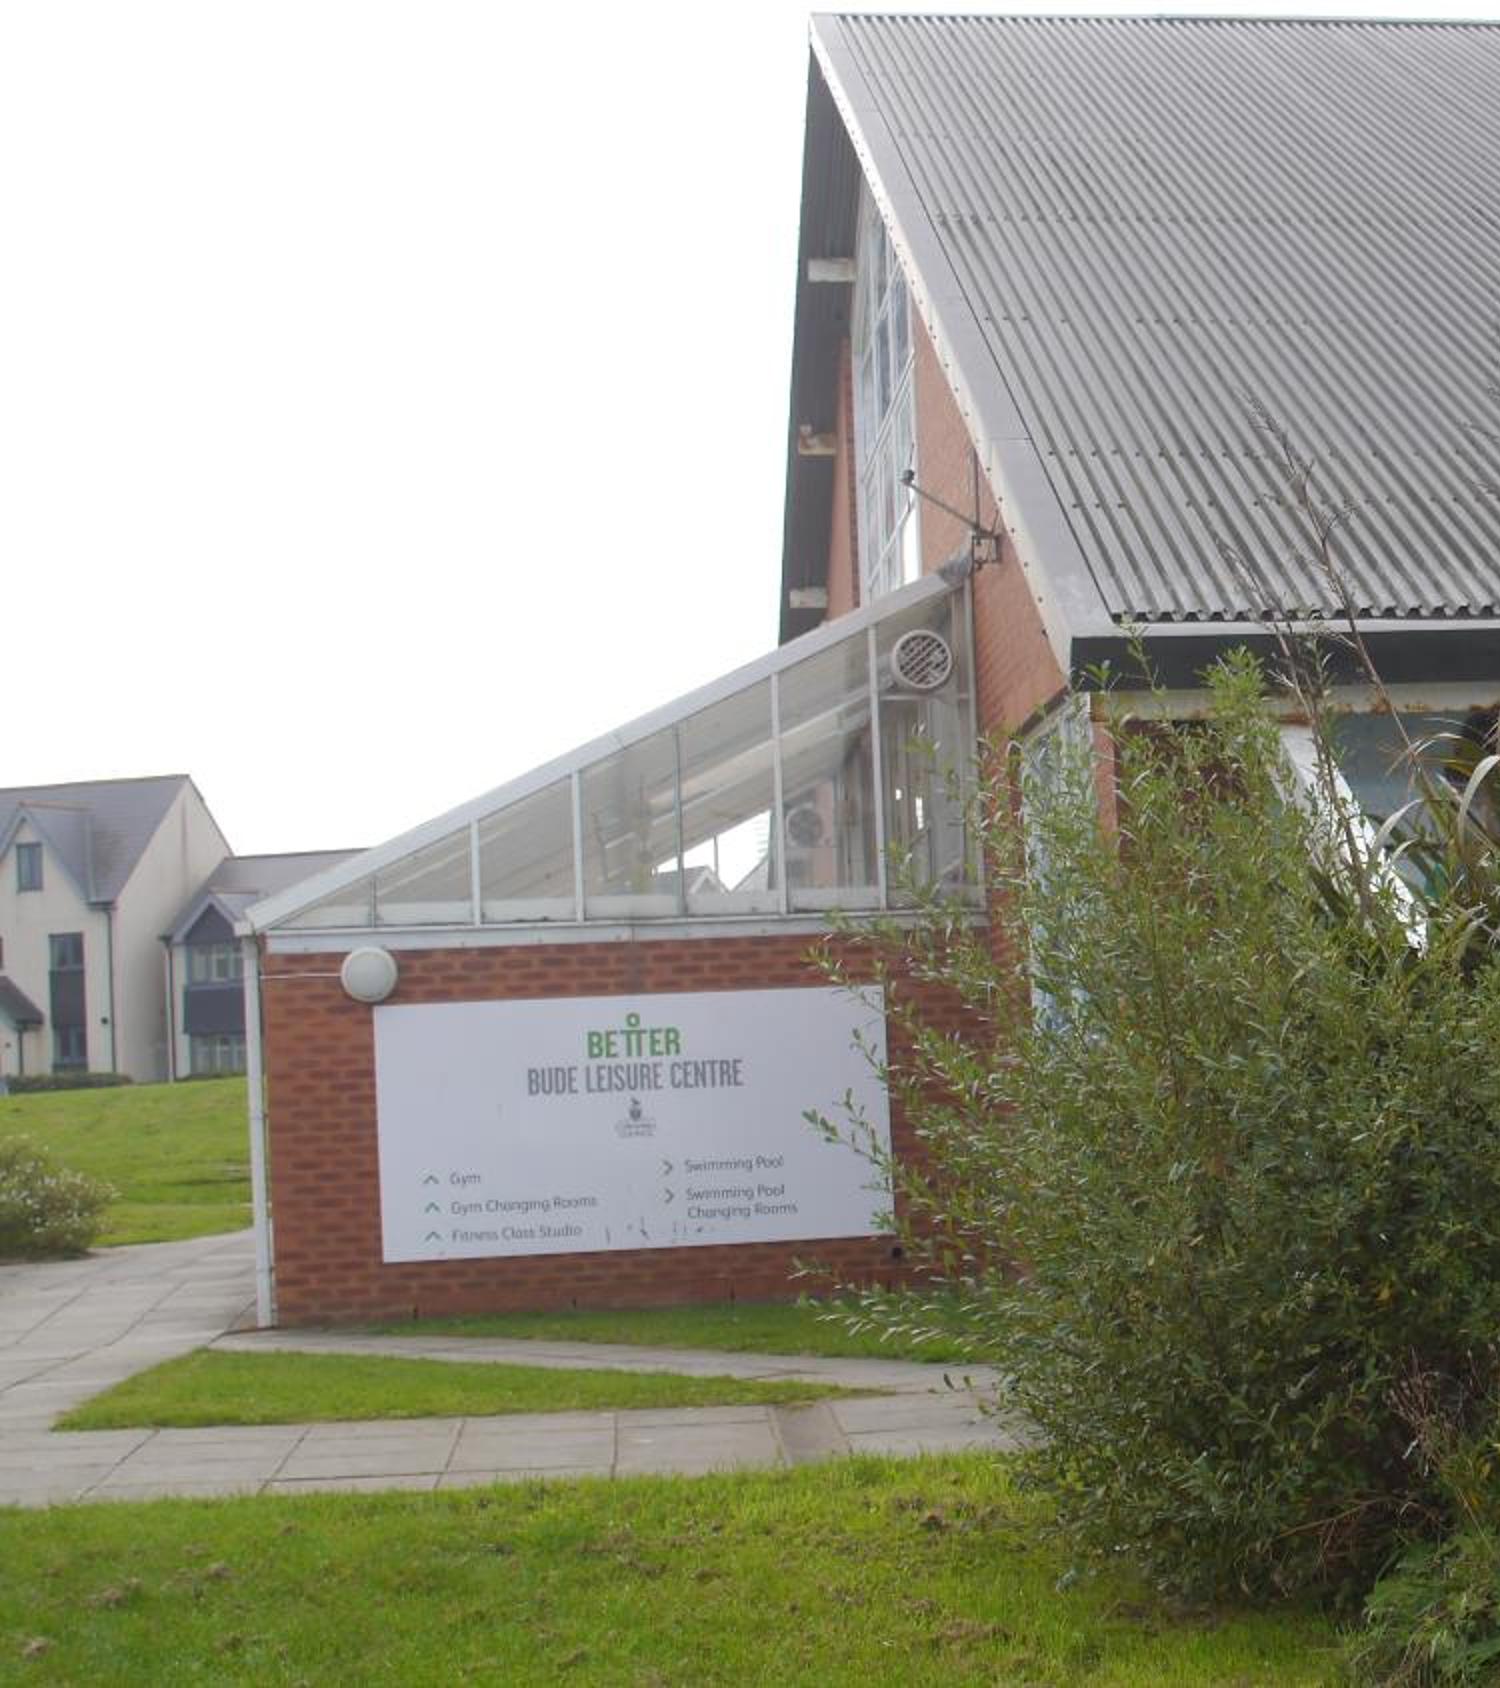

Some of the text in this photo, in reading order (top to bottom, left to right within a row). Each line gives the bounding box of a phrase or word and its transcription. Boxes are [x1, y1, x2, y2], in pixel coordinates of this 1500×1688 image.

[587, 1012, 681, 1059] BETTER
[527, 1059, 744, 1096] BUDE LEISURE CENTRE
[685, 1154, 784, 1174] Swimming Pool
[450, 1171, 482, 1188] Gym
[686, 1184, 785, 1202] Swimming Pool
[451, 1195, 599, 1216] Gym Changing Rooms
[687, 1202, 799, 1221] Changing Rooms
[539, 1224, 583, 1239] Studio
